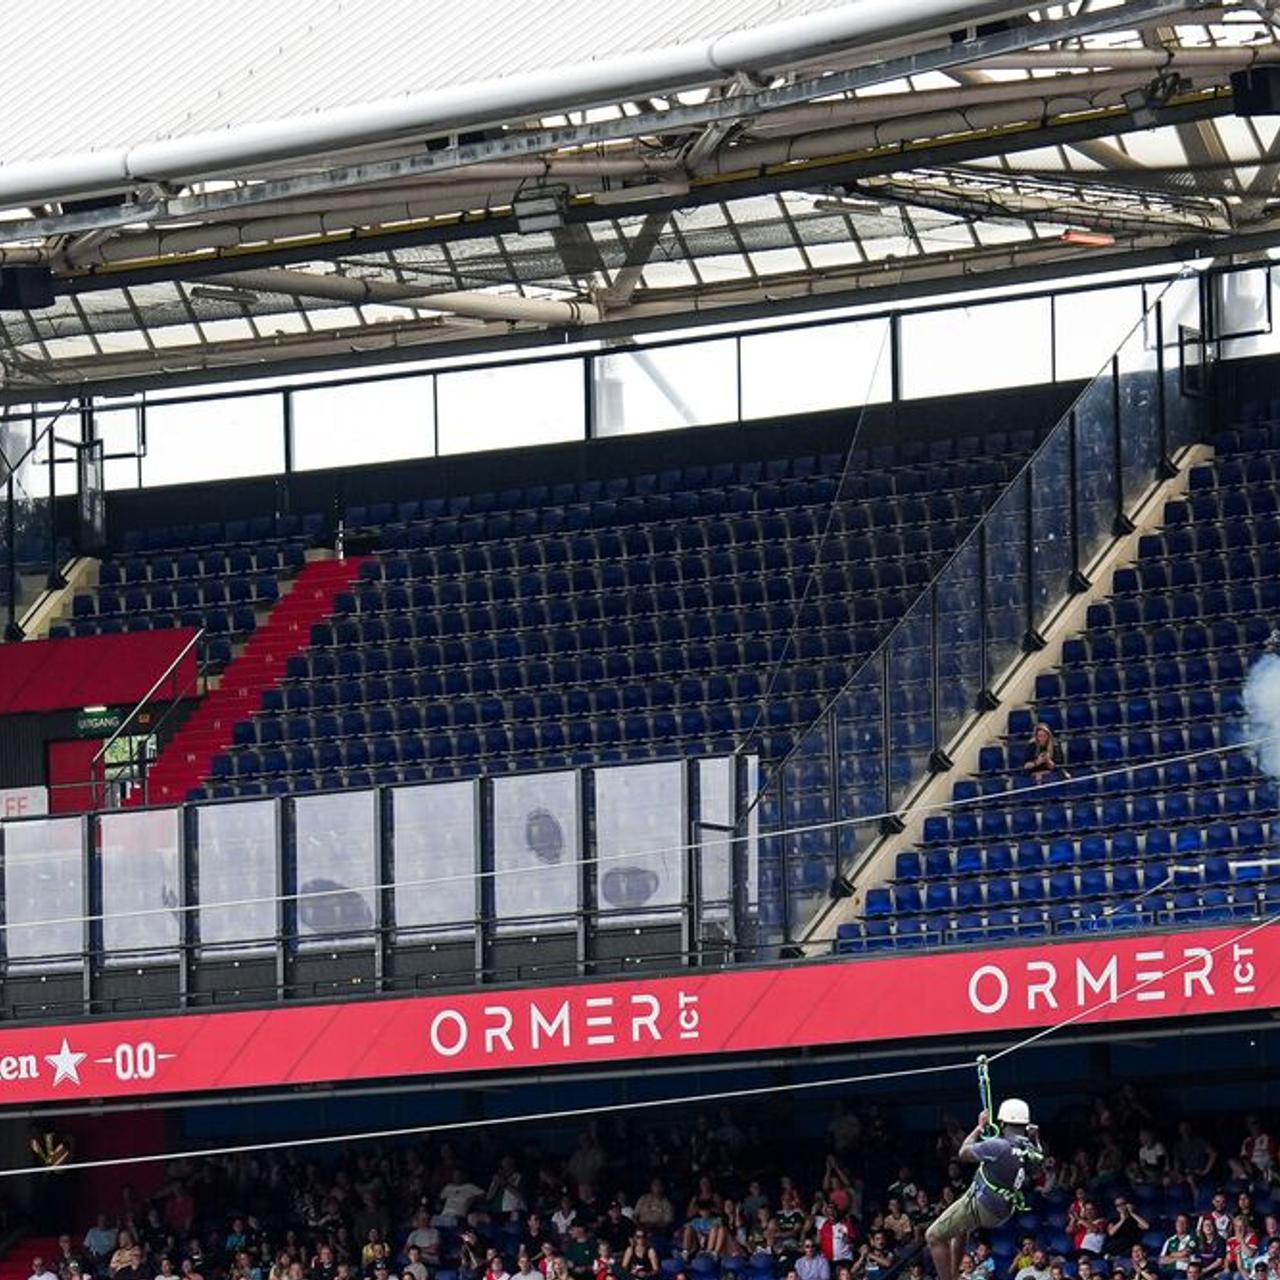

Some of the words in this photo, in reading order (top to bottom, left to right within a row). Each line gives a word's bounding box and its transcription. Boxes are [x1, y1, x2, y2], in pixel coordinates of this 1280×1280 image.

[969, 947, 1215, 1014] ORMER
[1233, 944, 1255, 994] ICT
[430, 994, 662, 1057] ORMER
[678, 991, 699, 1040] ICT
[114, 1041, 156, 1081] 0.0
